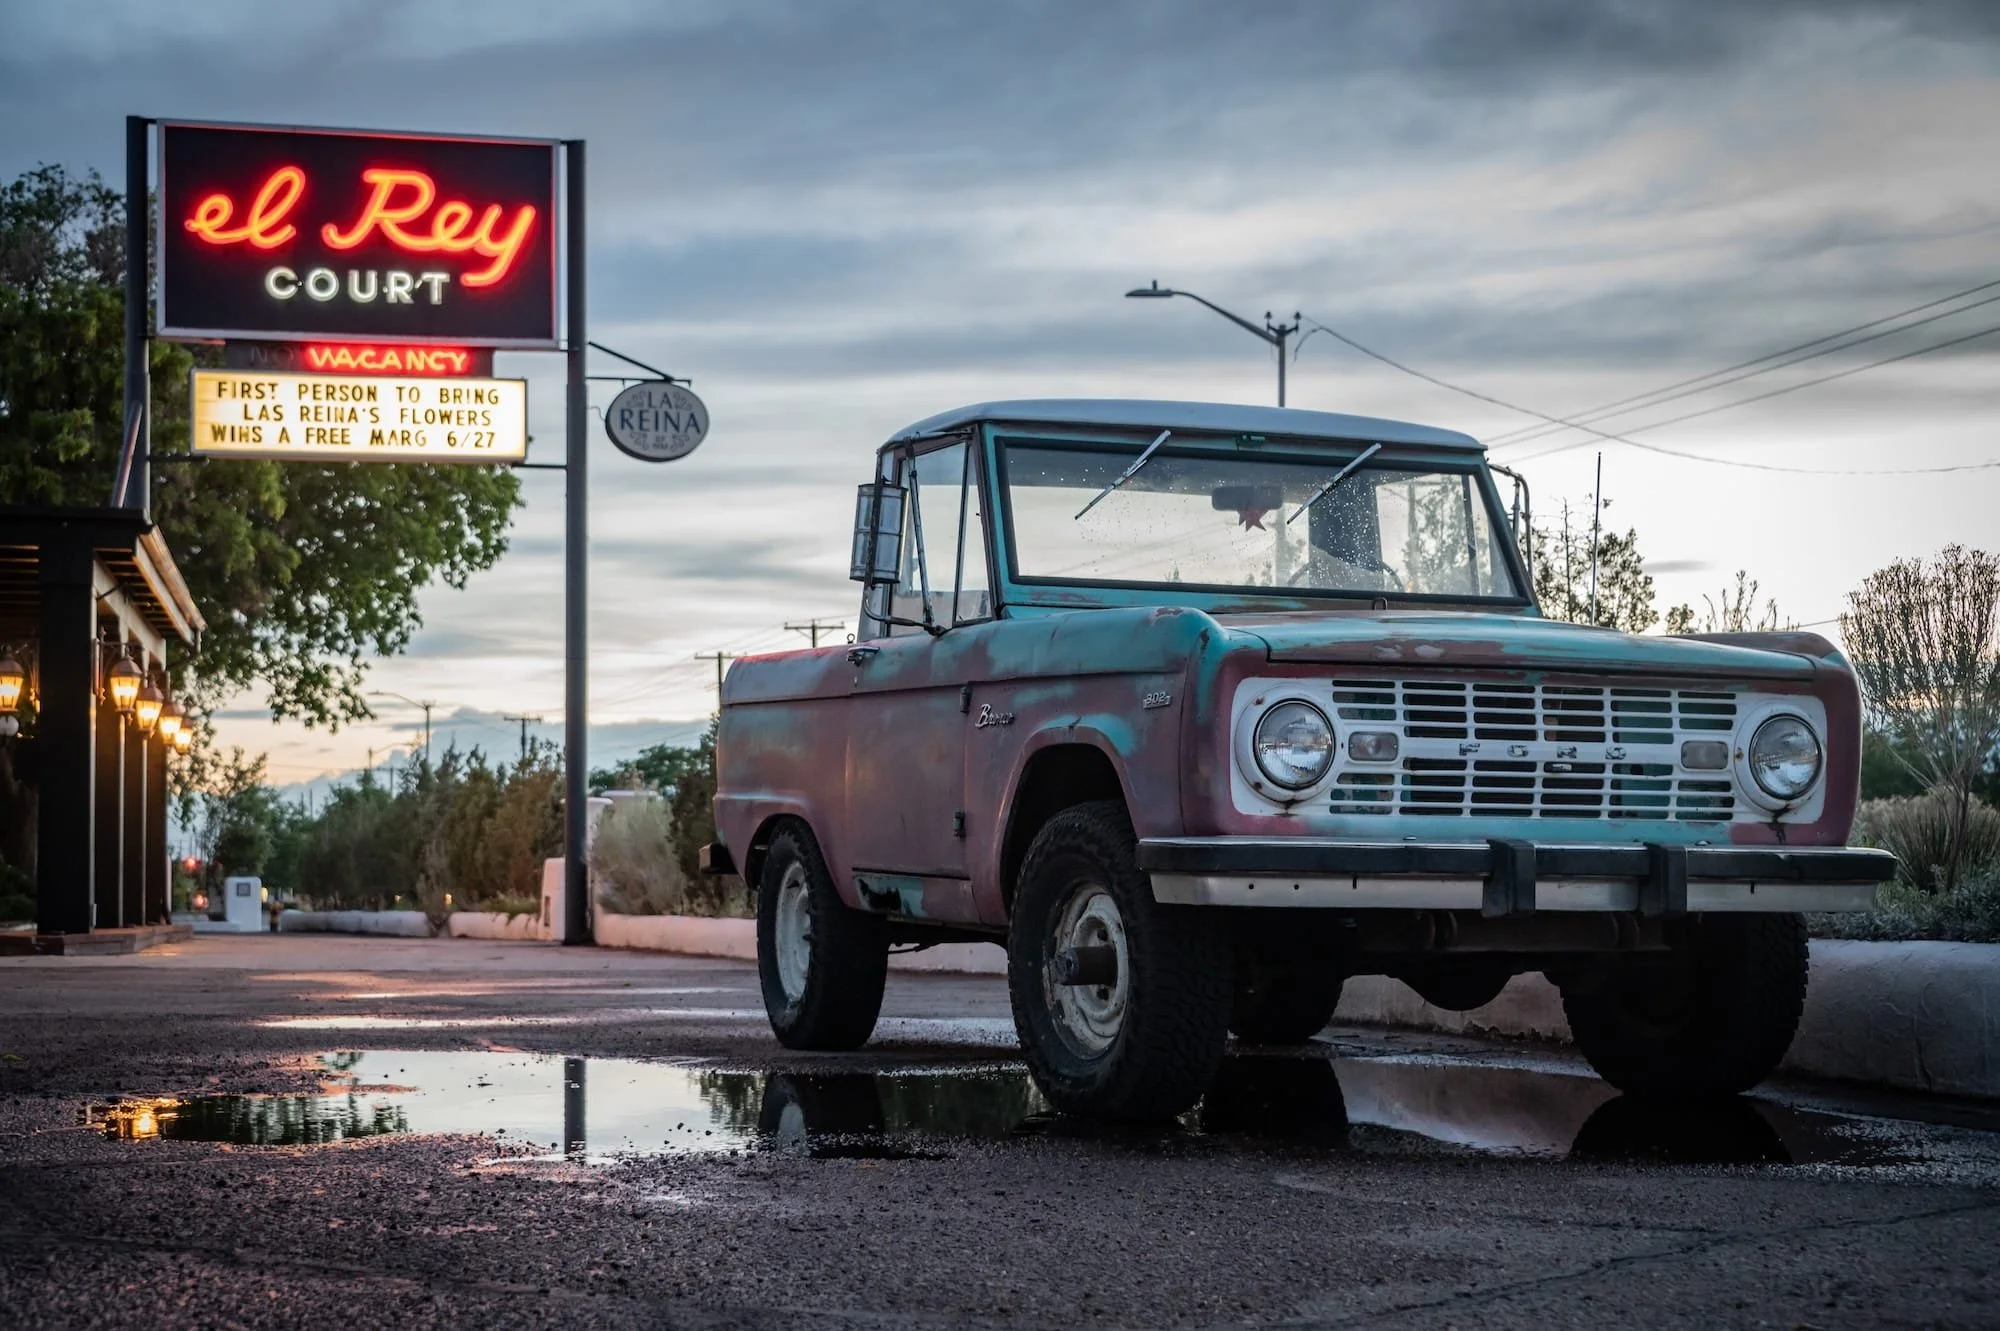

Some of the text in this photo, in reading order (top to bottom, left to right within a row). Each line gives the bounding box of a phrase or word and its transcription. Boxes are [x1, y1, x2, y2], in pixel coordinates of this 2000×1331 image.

[184, 166, 536, 287] el Rey
[265, 266, 450, 305] COURT
[308, 347, 468, 372] VACANCY
[217, 381, 499, 406] FIRST PERSON TO BRING
[648, 391, 673, 409] LA
[243, 404, 284, 422] LAS
[400, 408, 491, 427] FLOWERS
[621, 408, 700, 435] REINA
[278, 426, 290, 444] A
[305, 427, 351, 446] FREE
[370, 428, 427, 447] MARG
[447, 430, 495, 449] 6/27
